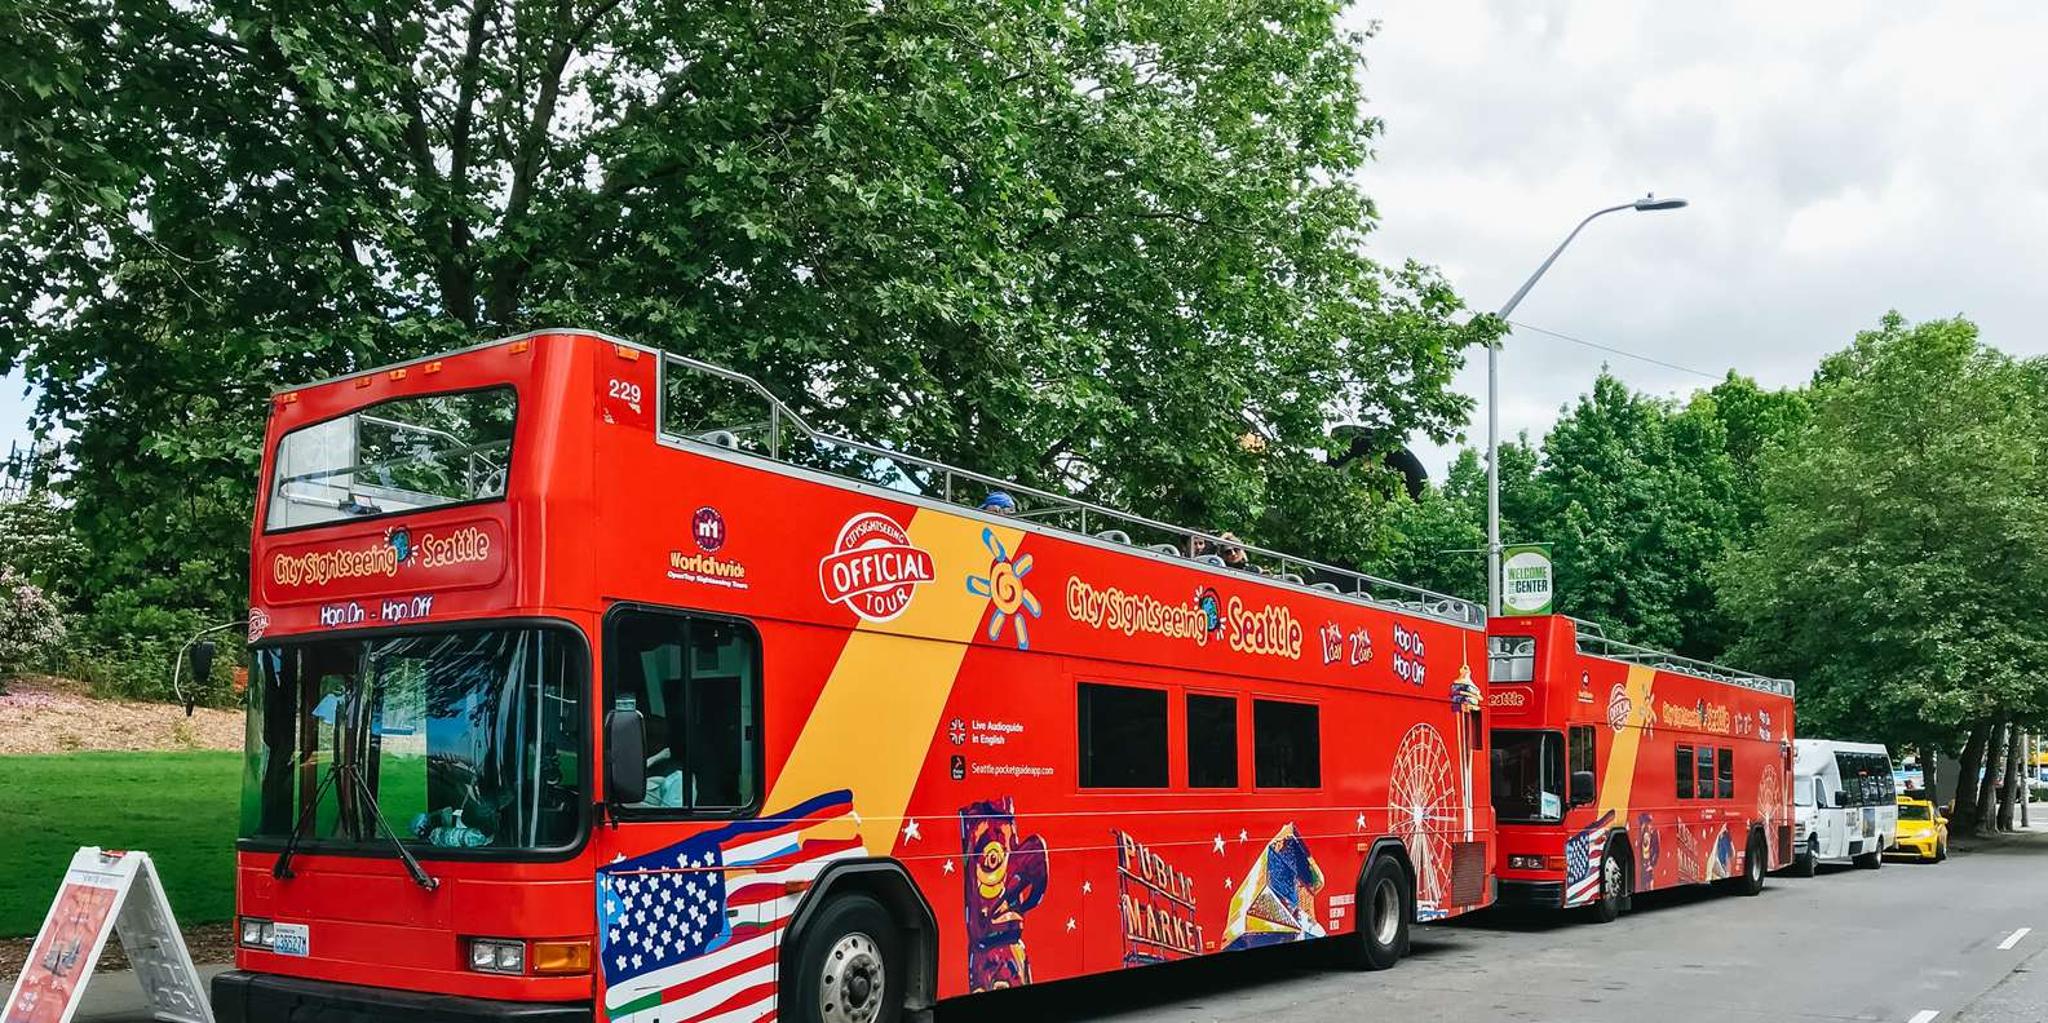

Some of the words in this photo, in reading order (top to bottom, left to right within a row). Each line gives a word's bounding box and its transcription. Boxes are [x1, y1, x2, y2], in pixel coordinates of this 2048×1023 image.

[609, 379, 641, 403] 229
[422, 527, 490, 567] Seattle
[670, 552, 745, 577] Worldwide
[833, 553, 929, 592] OFFICIAL
[1508, 566, 1547, 580] WELCOME
[866, 587, 909, 614] TOUR
[1516, 580, 1548, 593] CENTER
[321, 606, 345, 626] Hop
[348, 602, 364, 623] On
[382, 601, 408, 622] Hop
[411, 596, 434, 618] Off
[1228, 596, 1303, 660] Seattle
[1394, 623, 1412, 651] Hop
[1412, 633, 1425, 657] On
[1320, 627, 1330, 664] 1
[1349, 633, 1359, 665] 2
[1393, 653, 1411, 680] Hop
[1411, 661, 1425, 685] Off
[1488, 691, 1526, 706] eattle
[971, 720, 987, 730] Live
[987, 721, 1024, 734] Audioguide
[972, 734, 979, 743] in
[980, 735, 1005, 746] English
[1120, 831, 1196, 905] PUBLIC
[1121, 893, 1204, 954] MARKET
